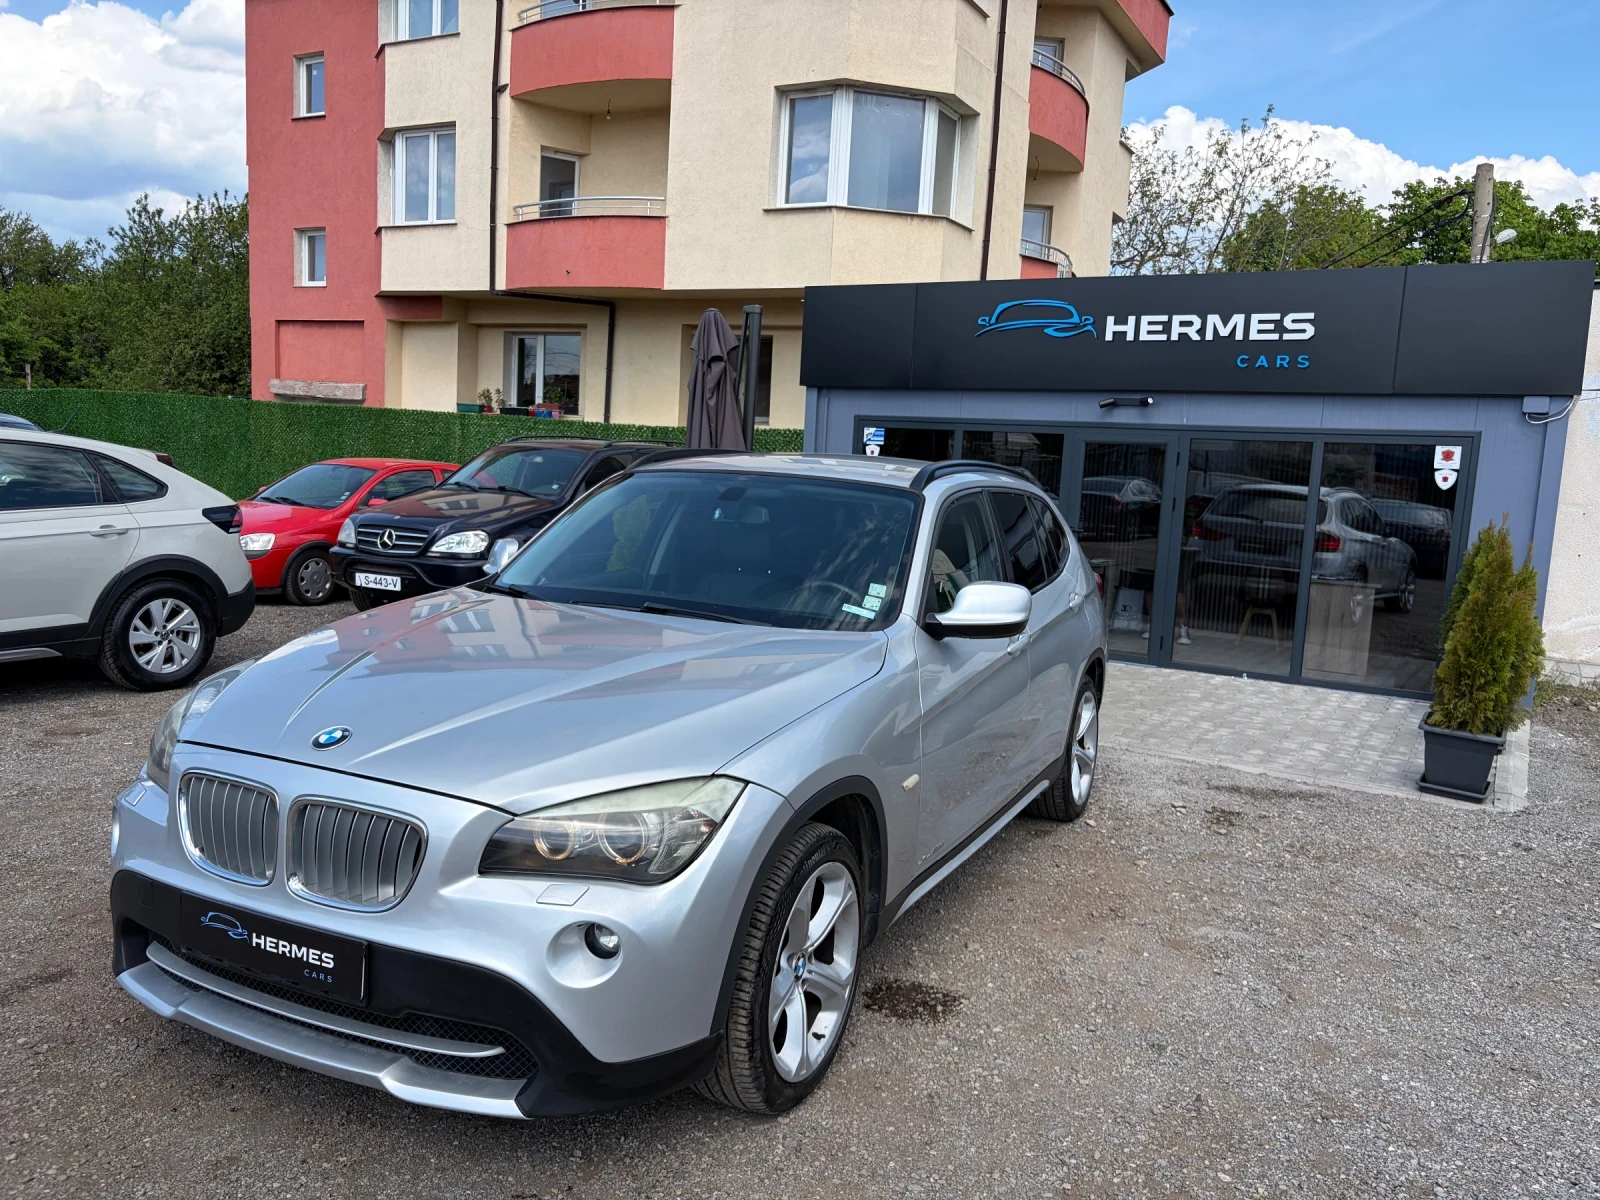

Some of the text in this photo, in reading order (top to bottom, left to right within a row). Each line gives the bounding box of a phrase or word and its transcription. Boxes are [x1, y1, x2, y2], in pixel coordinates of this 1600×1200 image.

[1105, 312, 1315, 341] HERMES
[1236, 354, 1311, 369] CARS
[364, 575, 398, 588] S-443-V
[252, 932, 334, 968] HERMES
[303, 969, 332, 983] CARS
